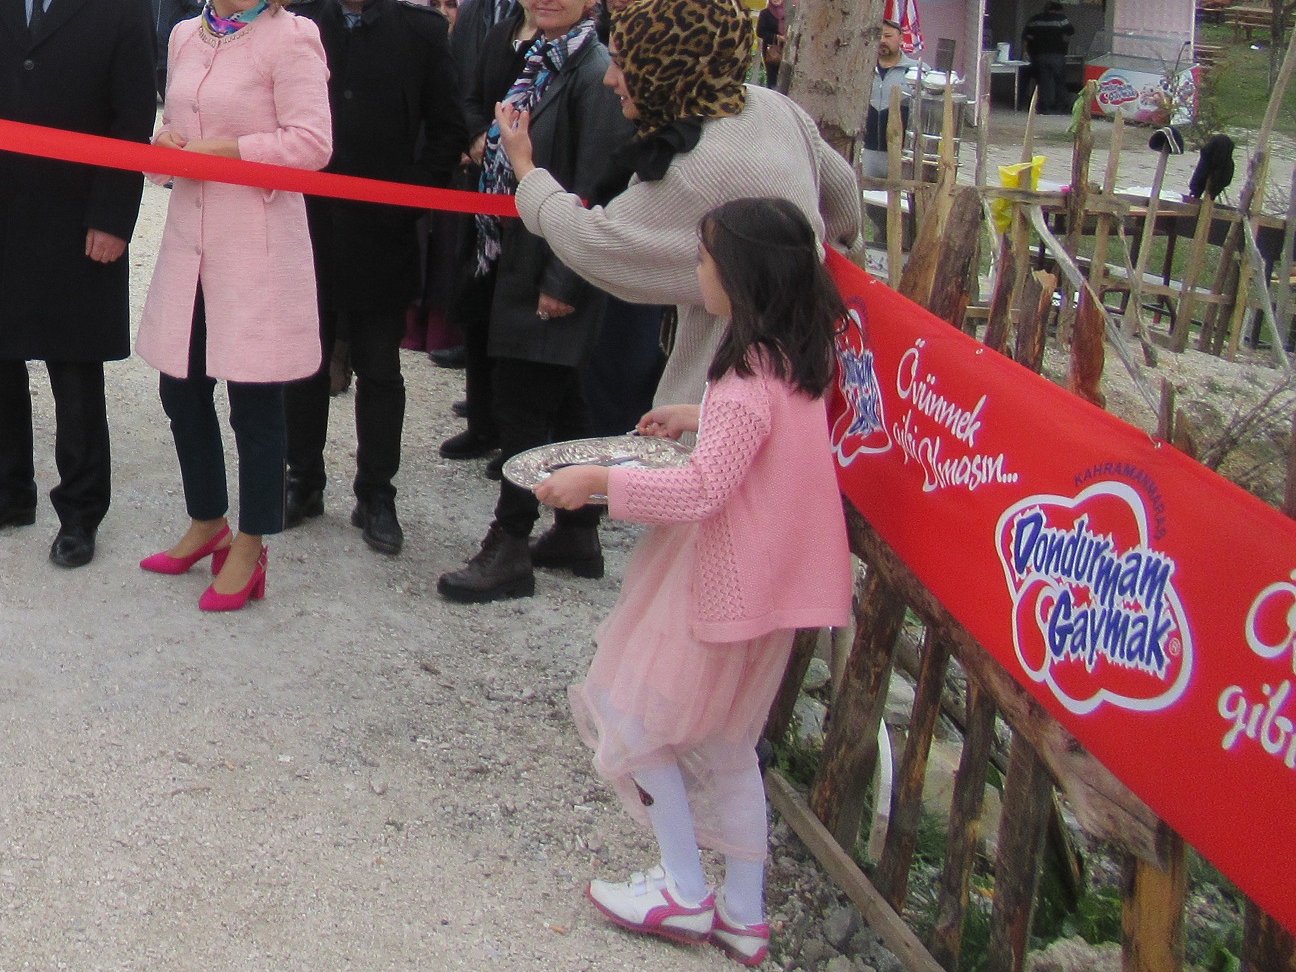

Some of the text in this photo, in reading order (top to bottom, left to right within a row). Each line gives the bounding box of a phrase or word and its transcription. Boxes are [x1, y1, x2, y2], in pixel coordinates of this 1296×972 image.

[897, 338, 987, 448] Övünmek
[1013, 512, 1170, 609] Dondurmam
[1048, 590, 1171, 671] Gaymak
